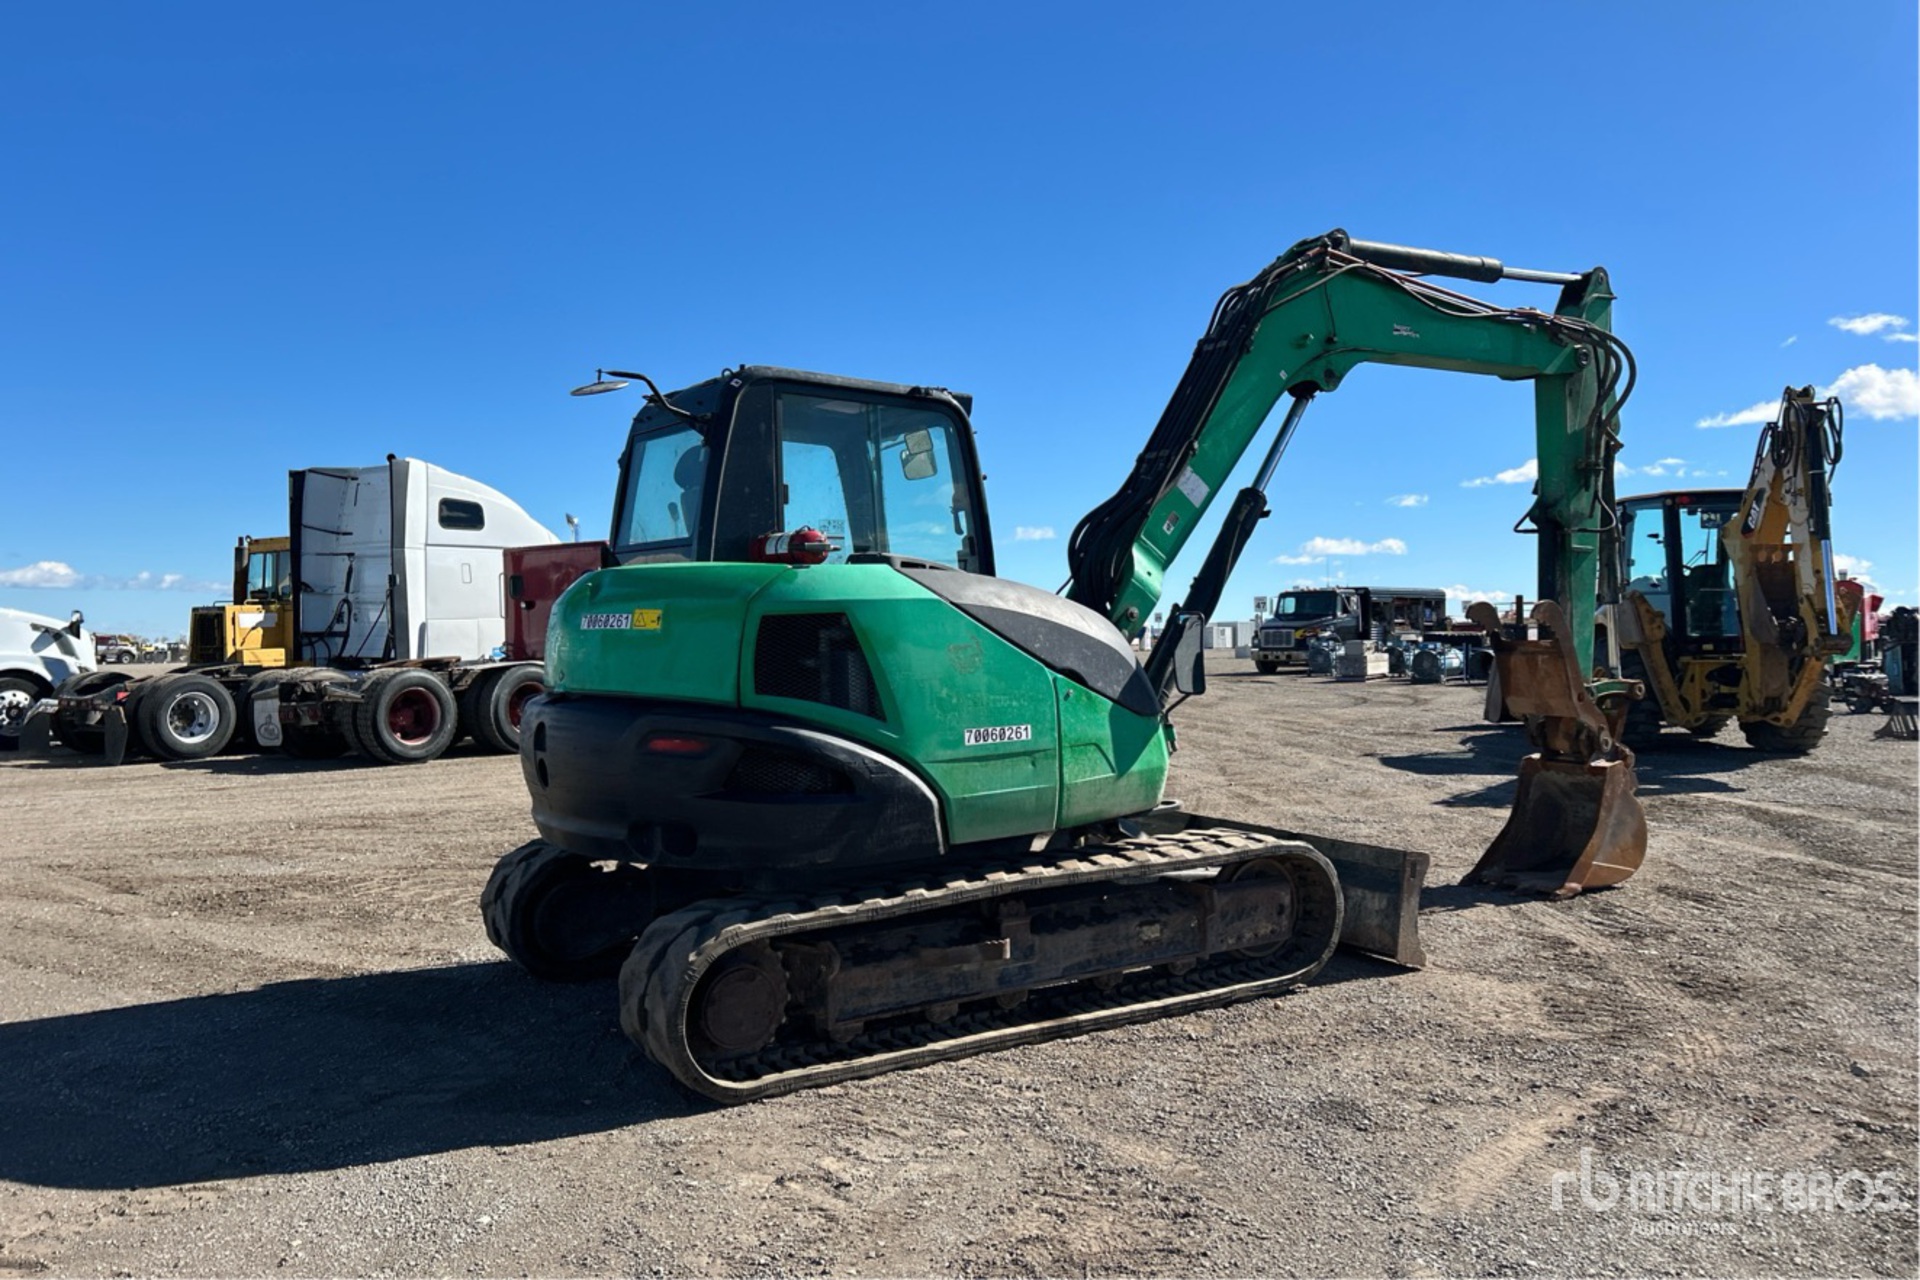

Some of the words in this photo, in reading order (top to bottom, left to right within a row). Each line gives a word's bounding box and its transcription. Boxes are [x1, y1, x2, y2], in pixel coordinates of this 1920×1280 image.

[1748, 500, 1760, 529] CAT
[582, 614, 630, 629] 70060261
[966, 726, 1029, 744] 70060261
